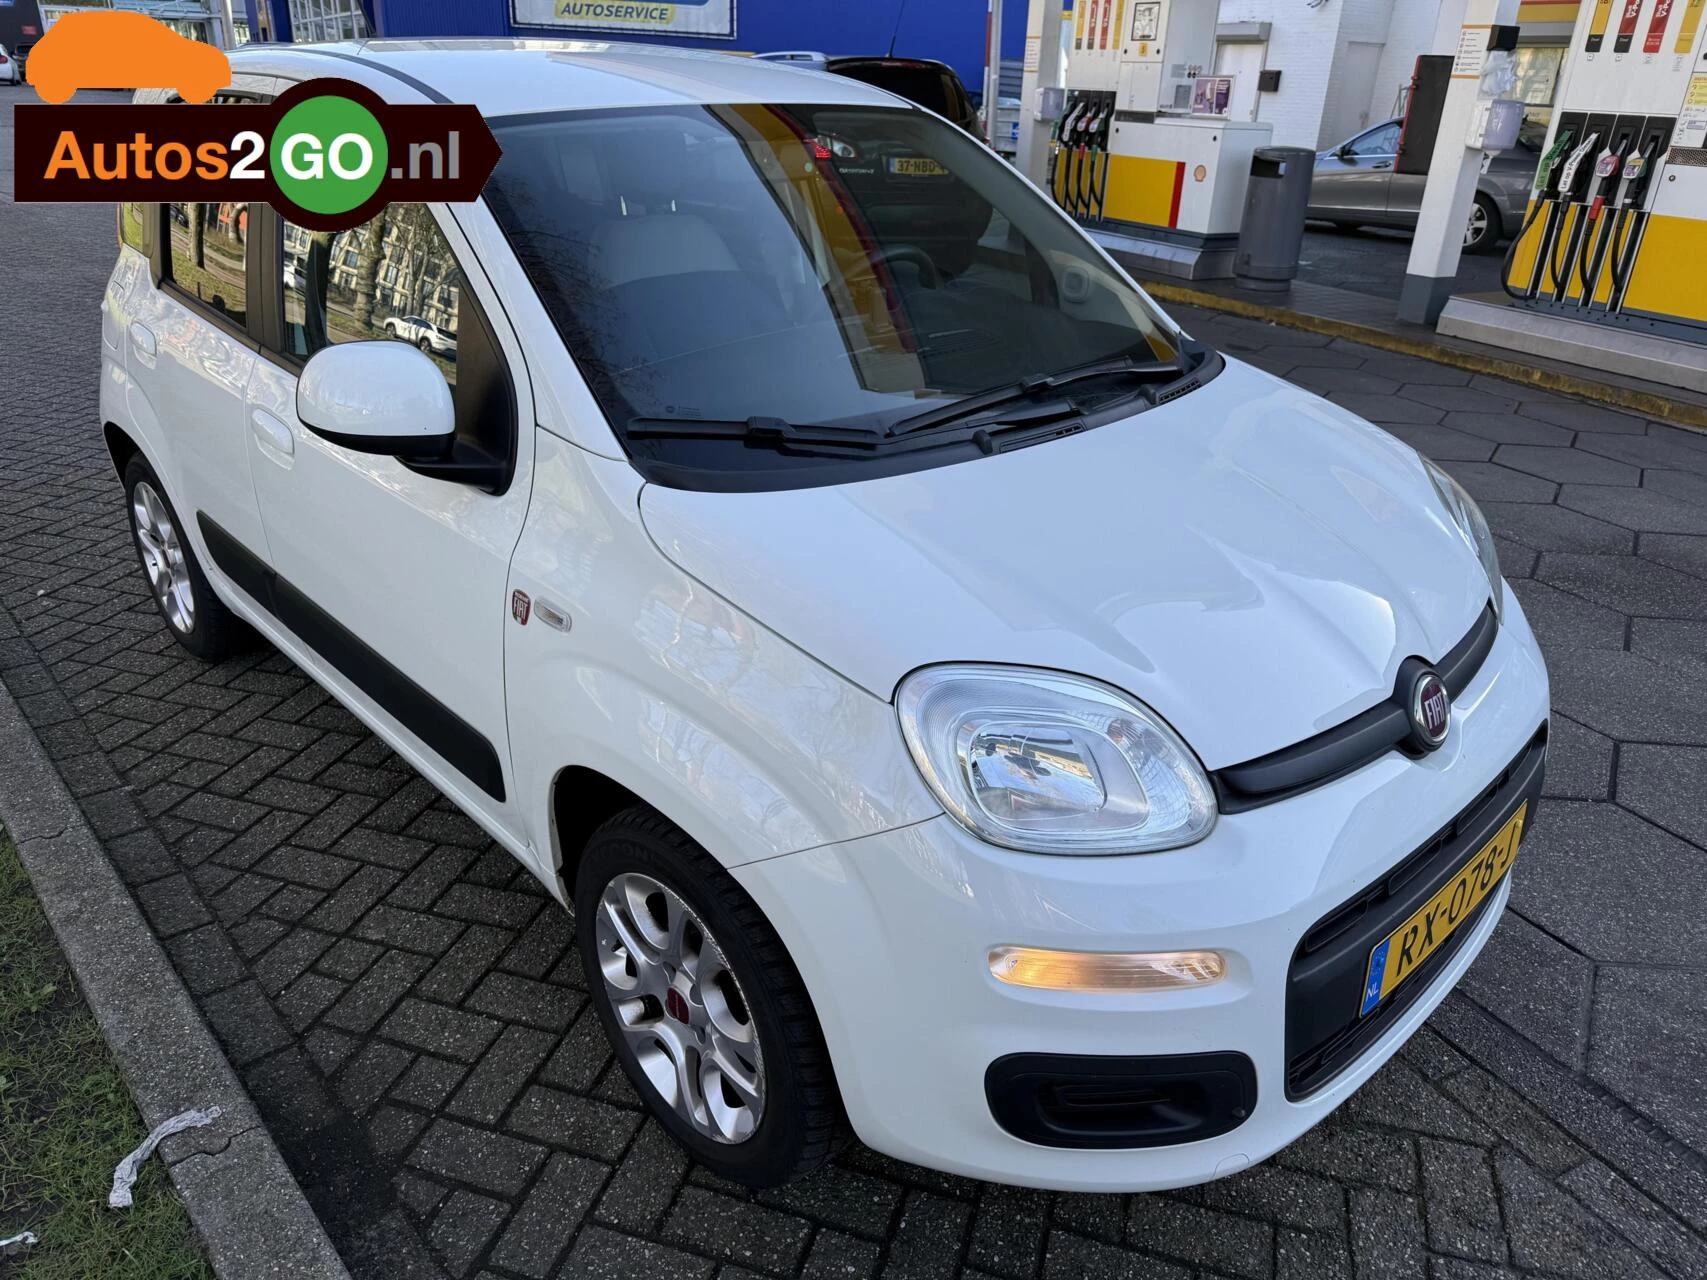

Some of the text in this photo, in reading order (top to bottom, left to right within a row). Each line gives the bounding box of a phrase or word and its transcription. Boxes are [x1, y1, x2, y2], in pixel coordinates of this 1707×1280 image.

[561, 2, 670, 21] AUTOSERVICE
[1423, 694, 1446, 730] FIAT
[1396, 827, 1519, 977] RX-078-J
[1366, 979, 1380, 999] NL
